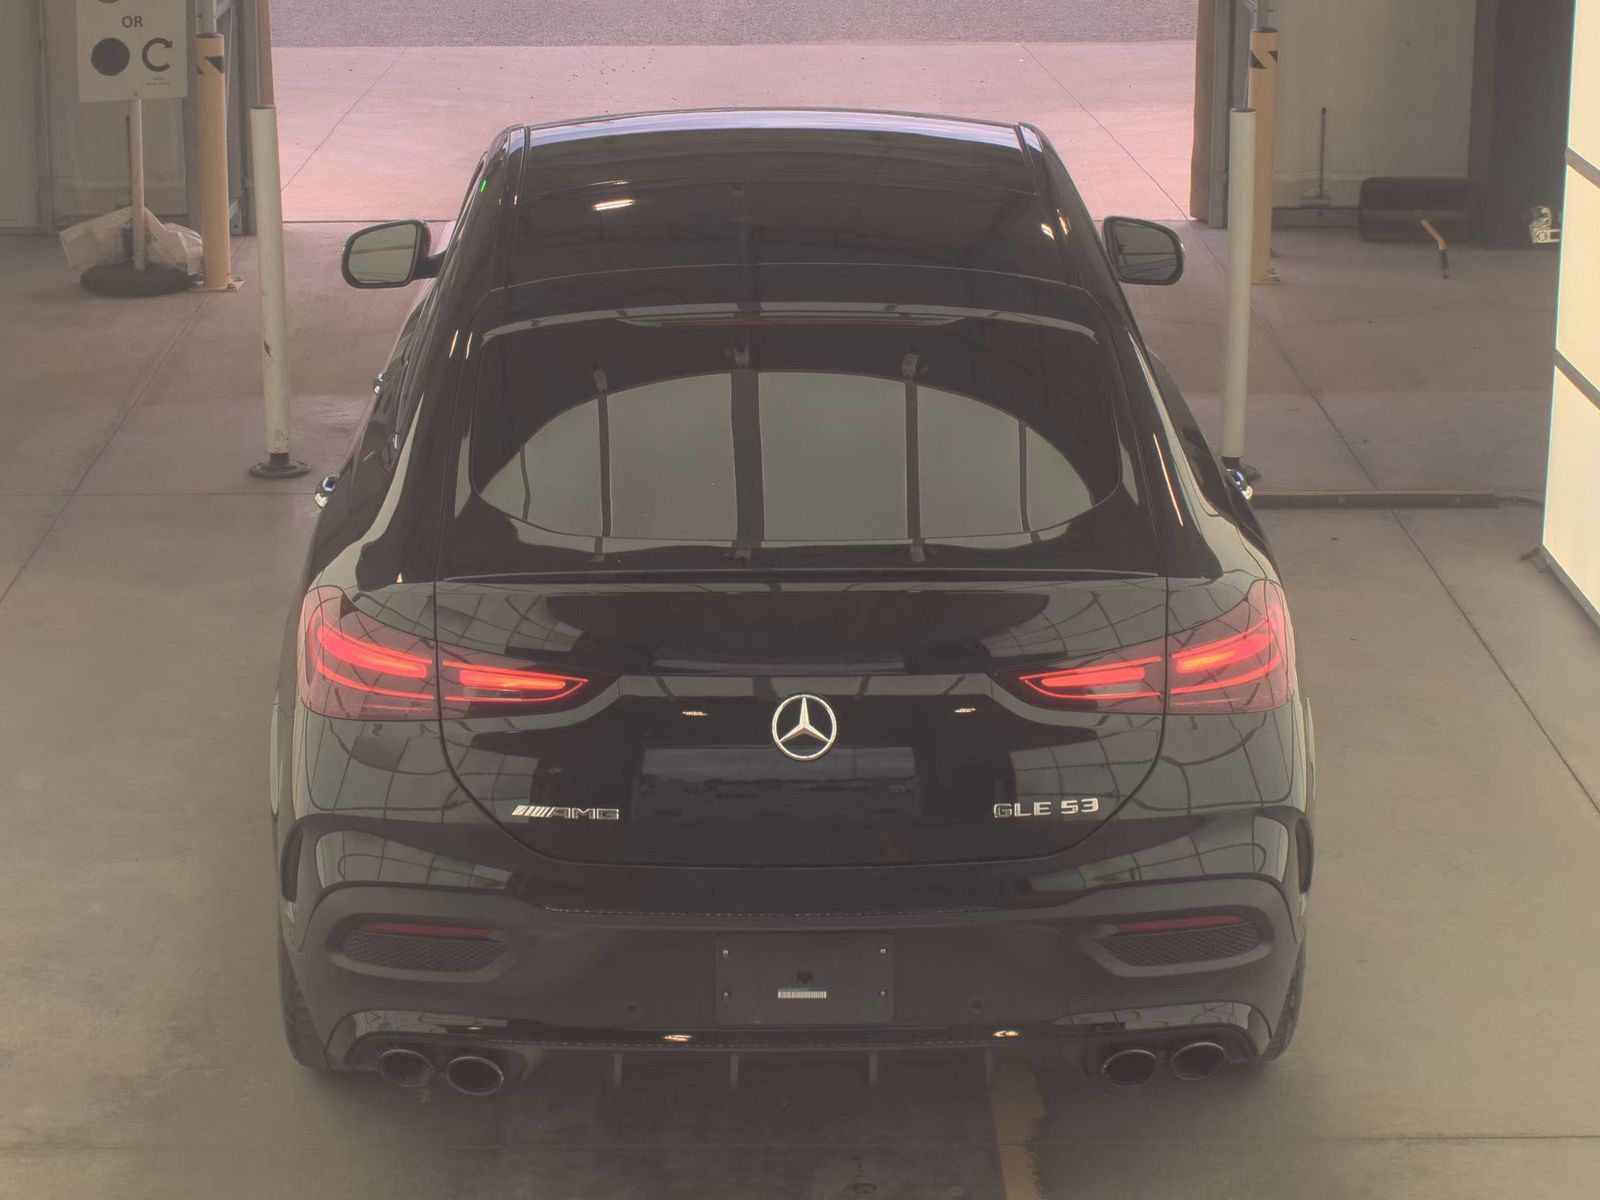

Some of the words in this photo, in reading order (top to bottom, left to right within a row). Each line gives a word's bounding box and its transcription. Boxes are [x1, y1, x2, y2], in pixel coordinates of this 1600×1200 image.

[121, 15, 143, 28] OR
[547, 806, 619, 820] AMG
[993, 801, 1052, 818] GLE
[1060, 797, 1099, 815] 53
